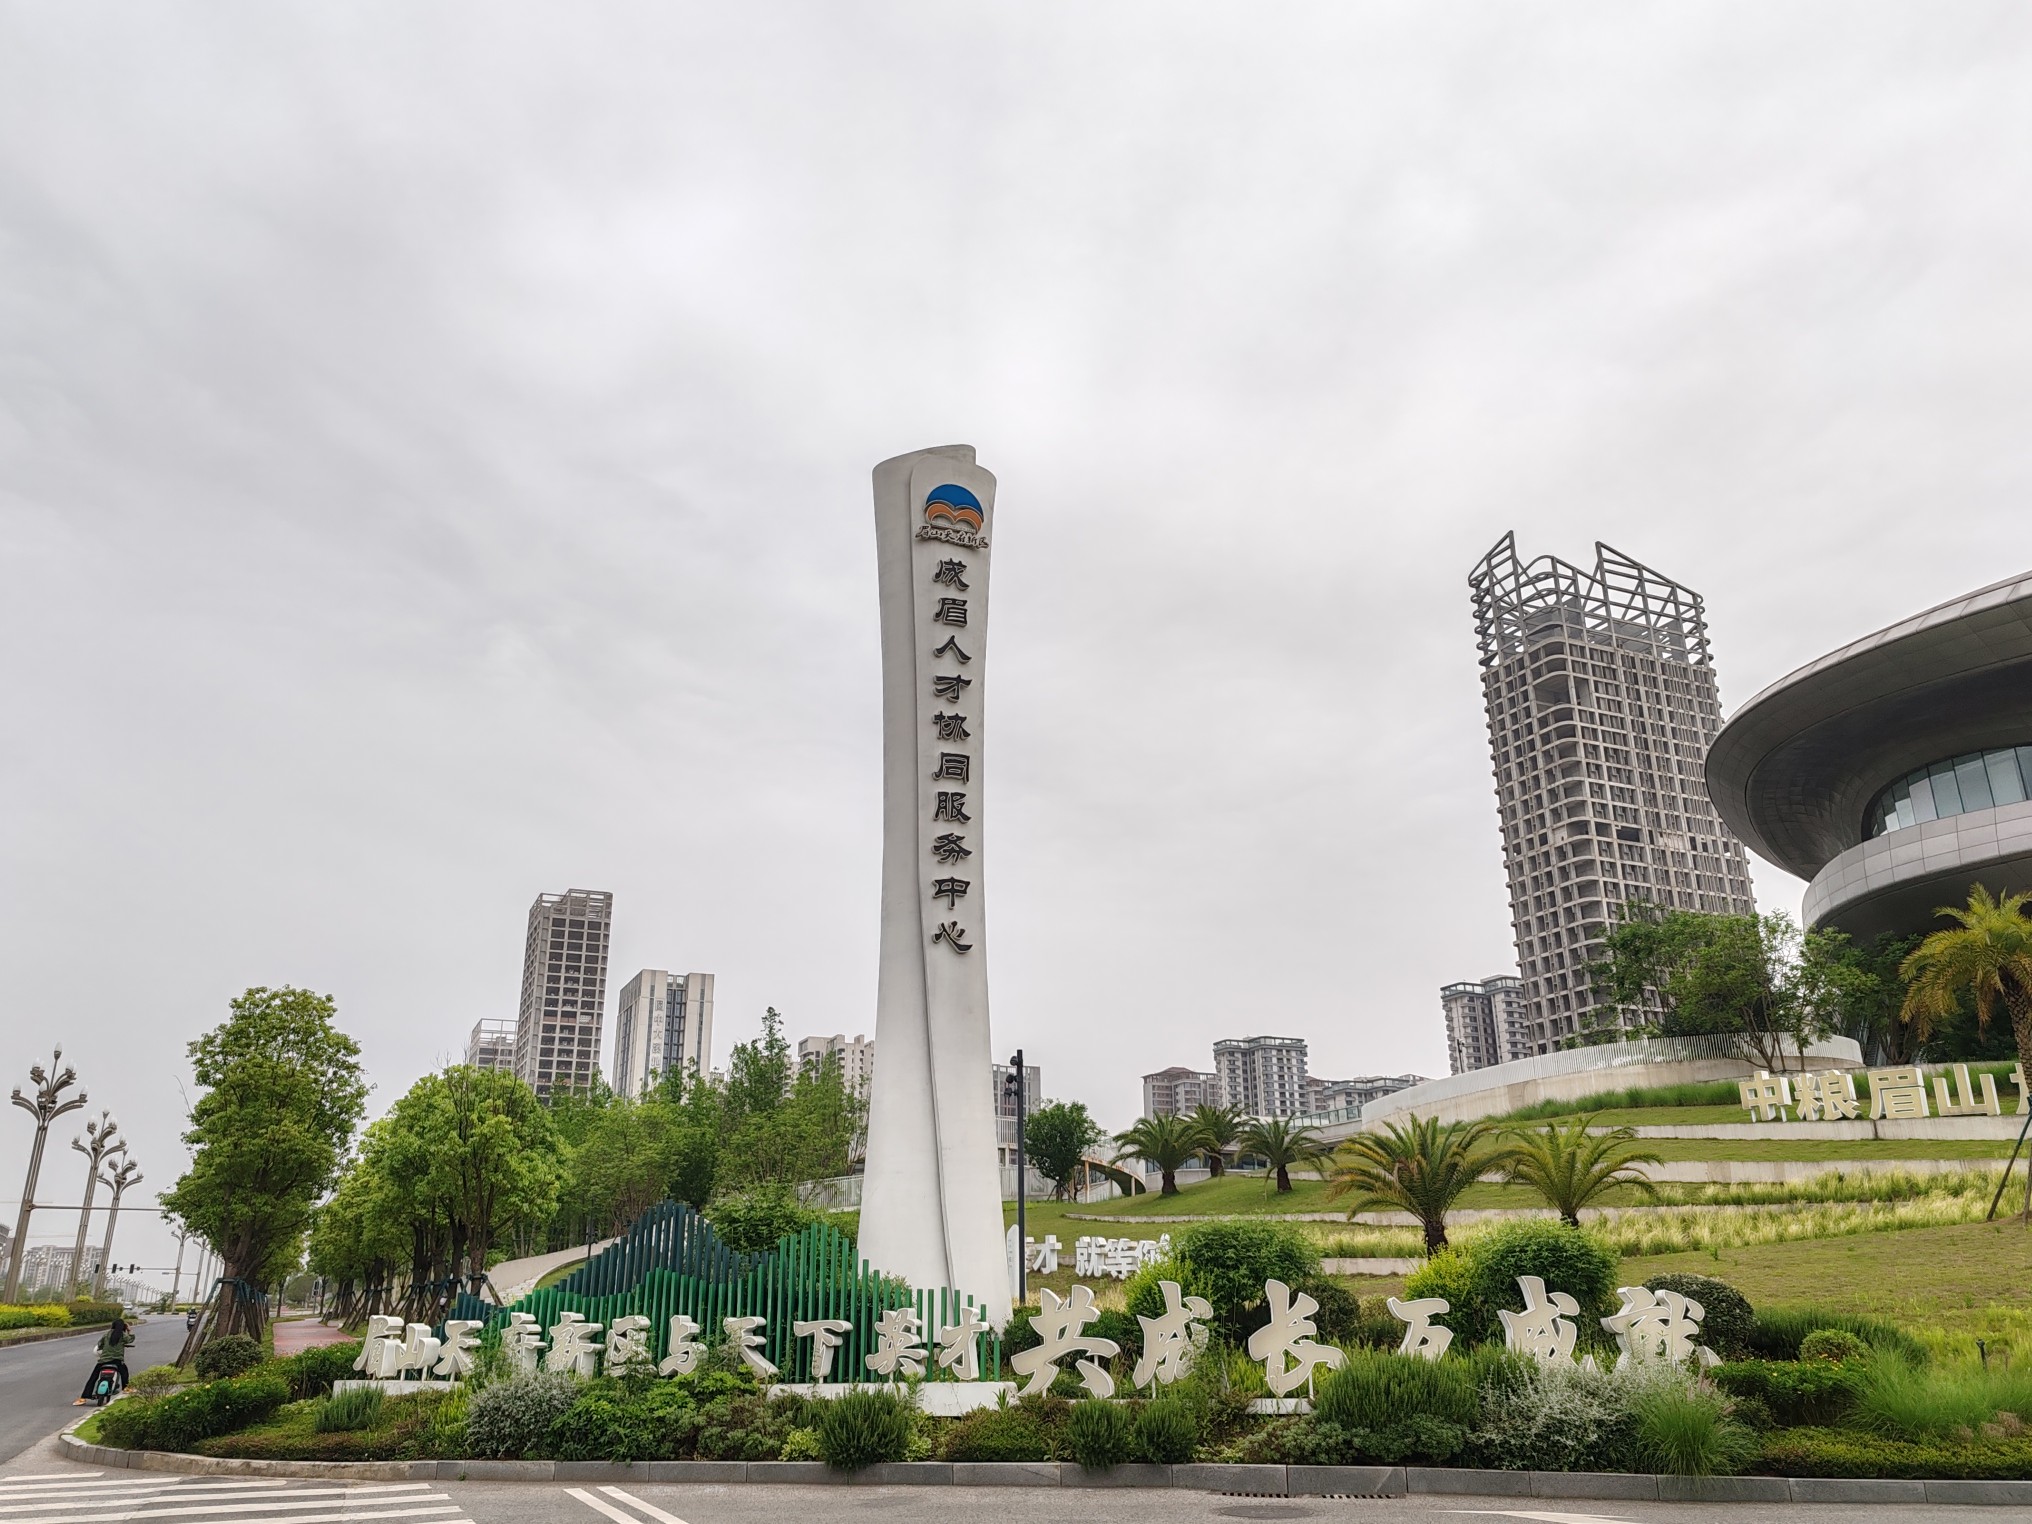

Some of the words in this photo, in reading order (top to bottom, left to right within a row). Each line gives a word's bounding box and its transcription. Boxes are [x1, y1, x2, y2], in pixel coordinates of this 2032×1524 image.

[931, 557, 973, 954] 成眉人才协同服务中心
